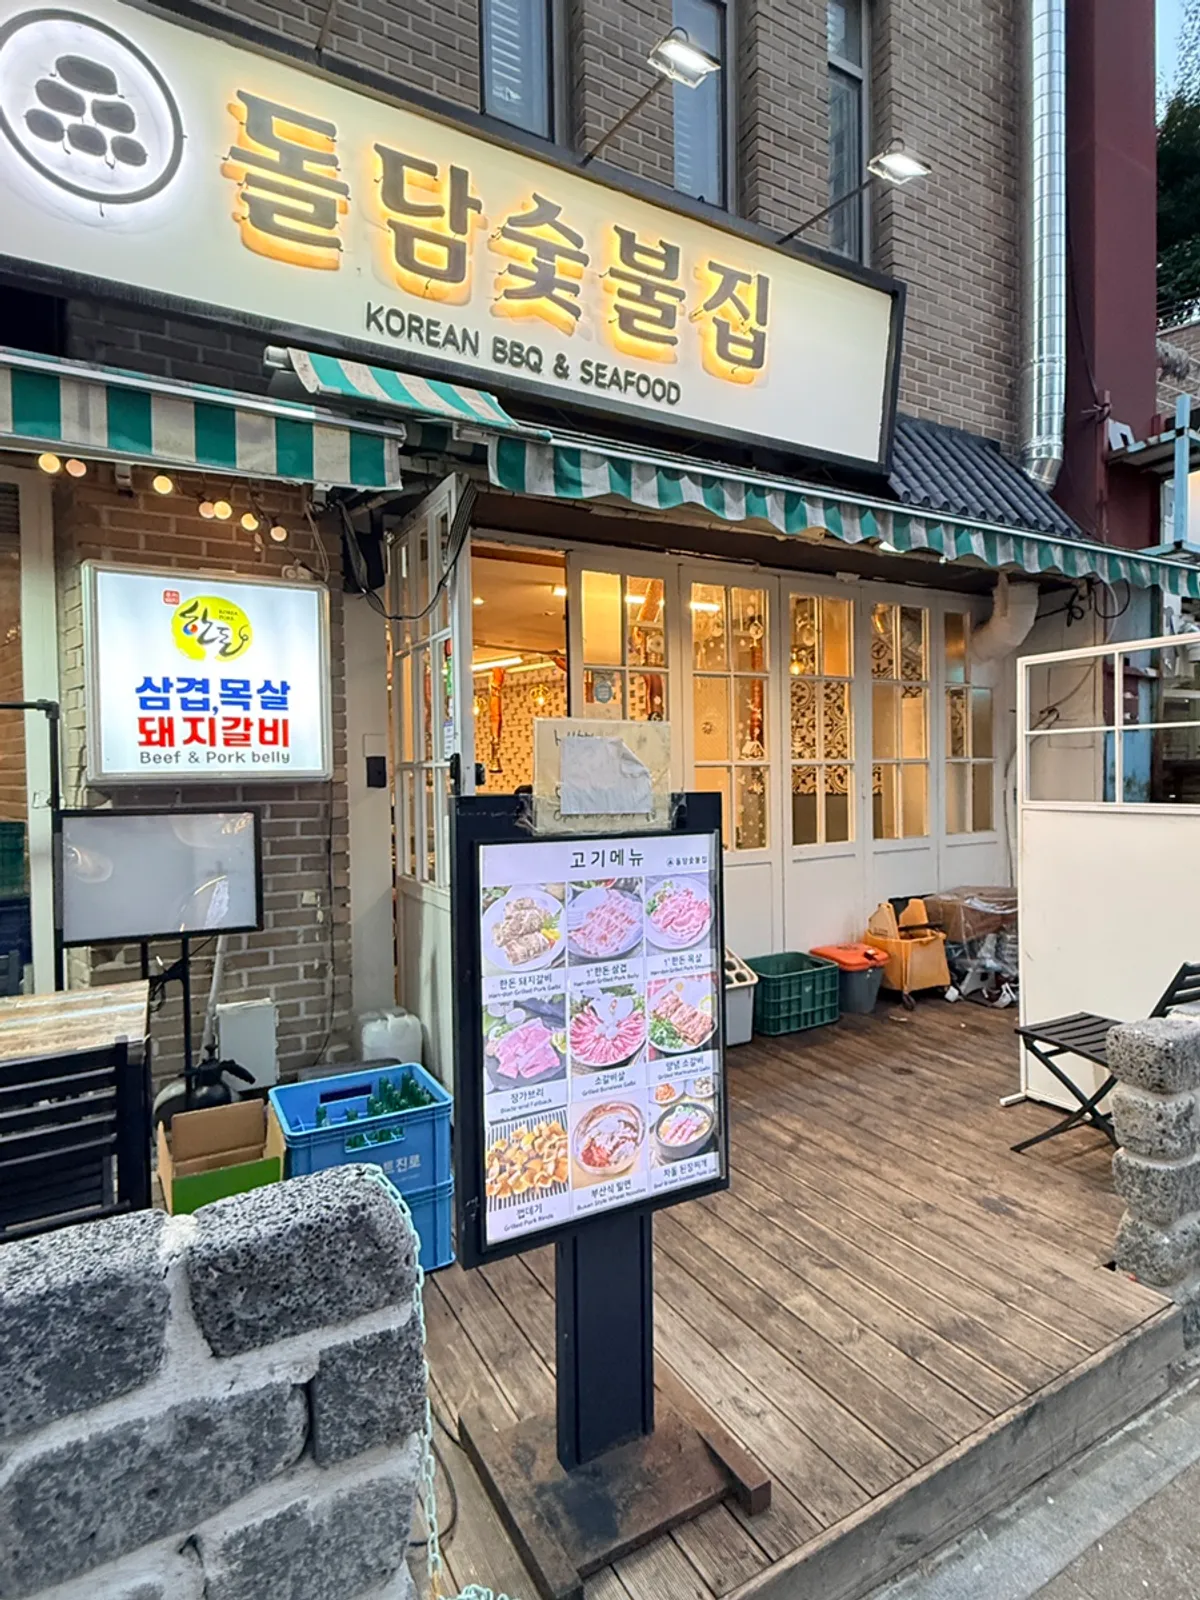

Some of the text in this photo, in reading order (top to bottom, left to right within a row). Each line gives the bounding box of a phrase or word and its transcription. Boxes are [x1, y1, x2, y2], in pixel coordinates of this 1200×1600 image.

[223, 89, 770, 374] 돌담숯불집
[365, 301, 681, 406] KOREAN BBQ & SEAFOOD
[135, 676, 291, 715] 삼겹,목살
[137, 717, 290, 748] 돼지갈비
[140, 750, 290, 764] Beef & Pork belly
[569, 848, 644, 869] 고기메뉴
[518, 973, 552, 986] 돼지갈비
